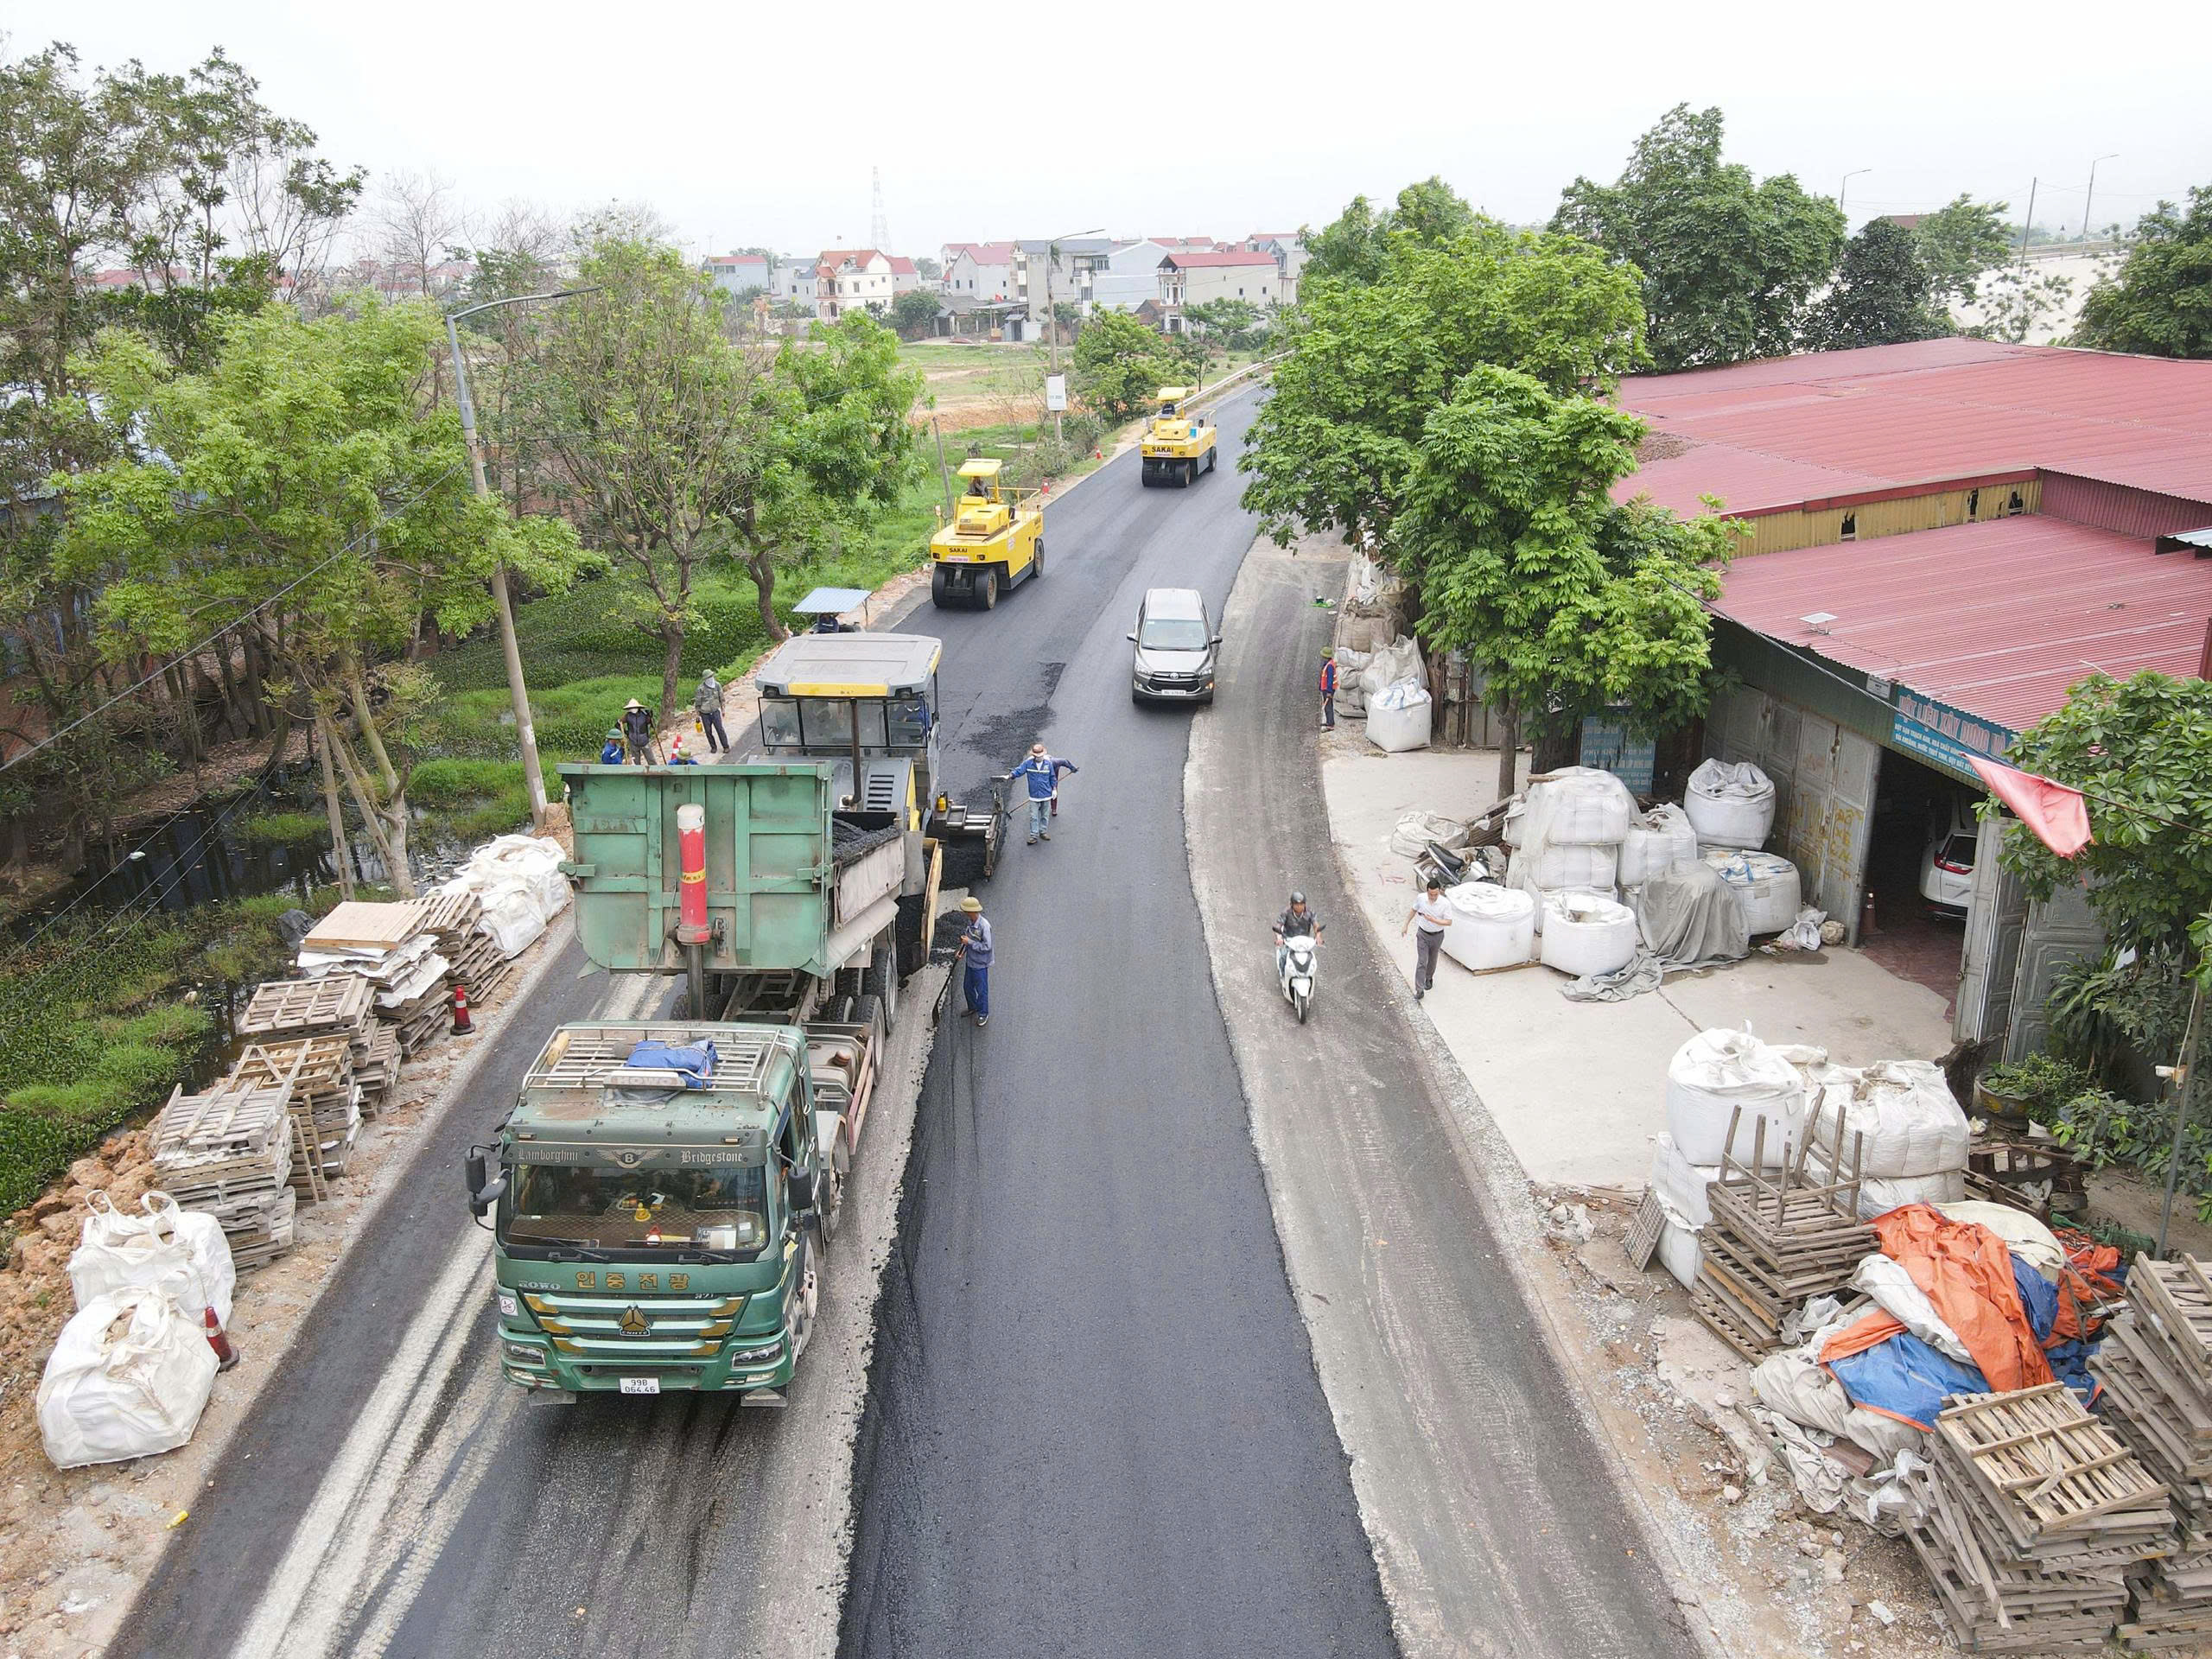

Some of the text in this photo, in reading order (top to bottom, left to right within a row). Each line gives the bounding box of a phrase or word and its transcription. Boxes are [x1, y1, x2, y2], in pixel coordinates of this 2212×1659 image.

[518, 1148, 578, 1163] Lamborghini
[625, 1154, 634, 1163] B
[680, 1149, 743, 1165] Bridgestone
